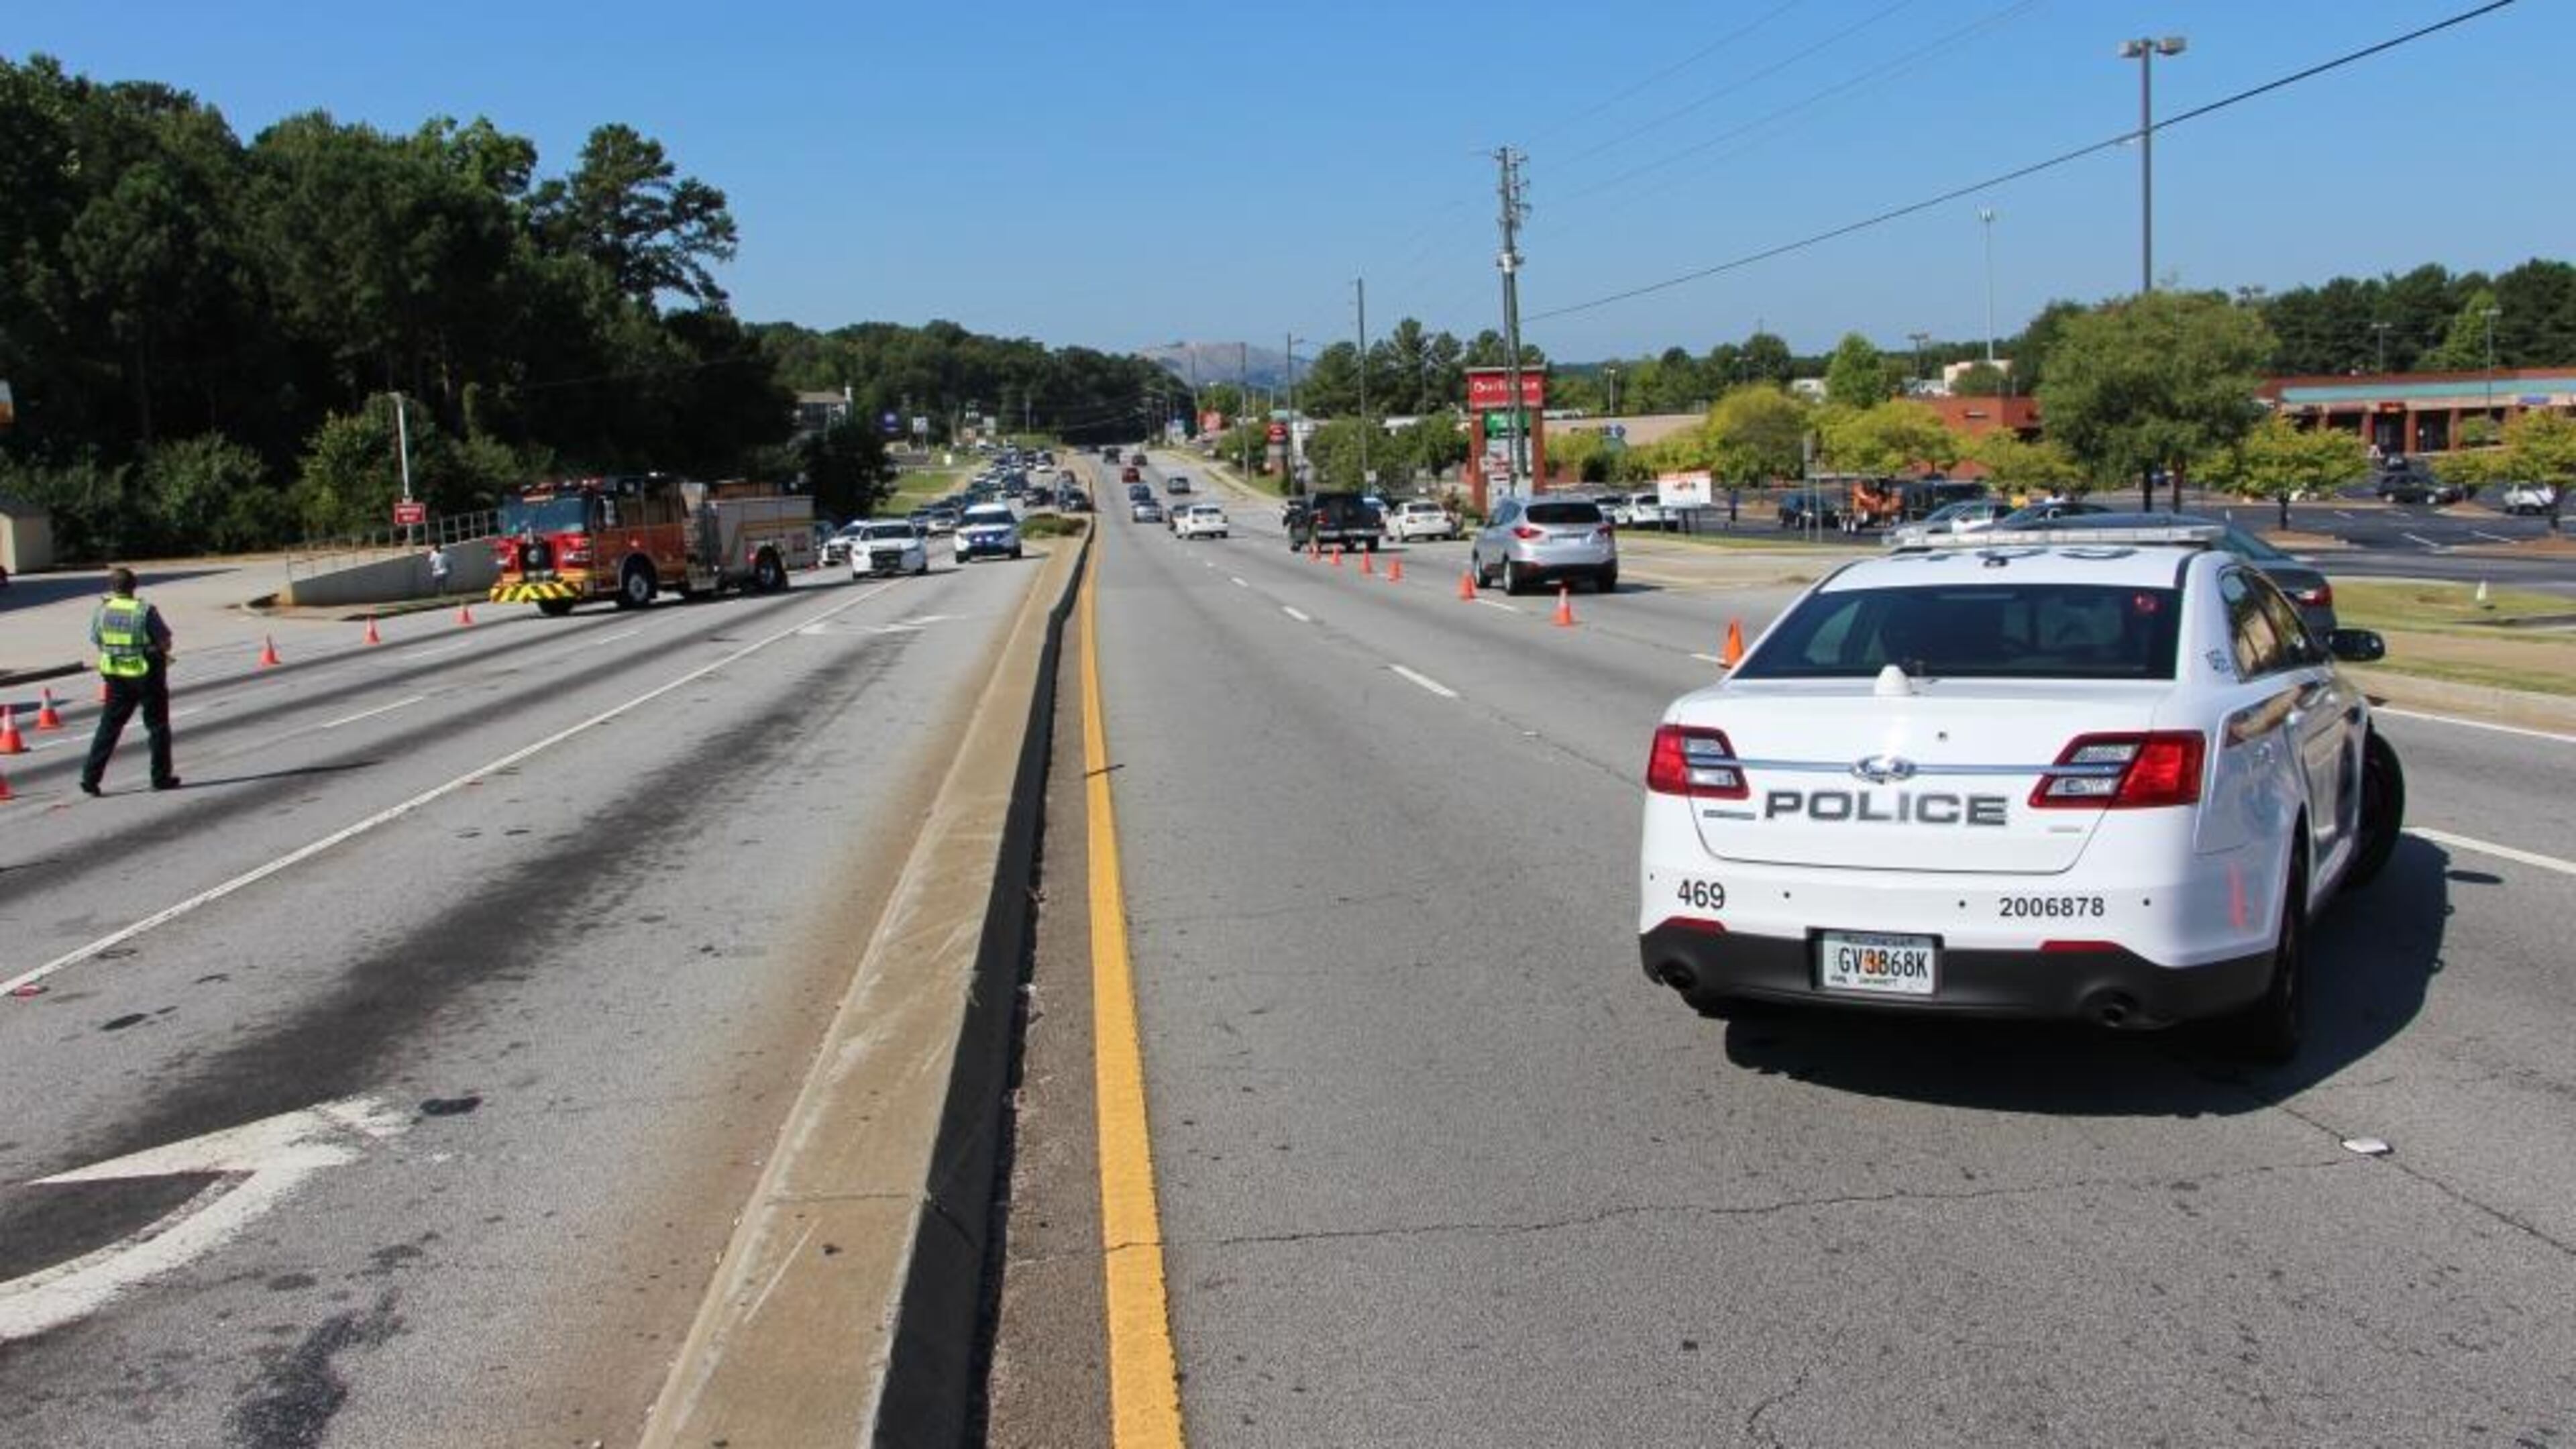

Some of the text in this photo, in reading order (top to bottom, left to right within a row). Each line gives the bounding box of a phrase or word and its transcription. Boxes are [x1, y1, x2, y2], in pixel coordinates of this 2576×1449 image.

[1765, 790, 2007, 826] POLICE
[1678, 879, 1725, 909] 469
[1999, 896, 2104, 917] 2006878
[1838, 947, 1928, 978] GV3868K
